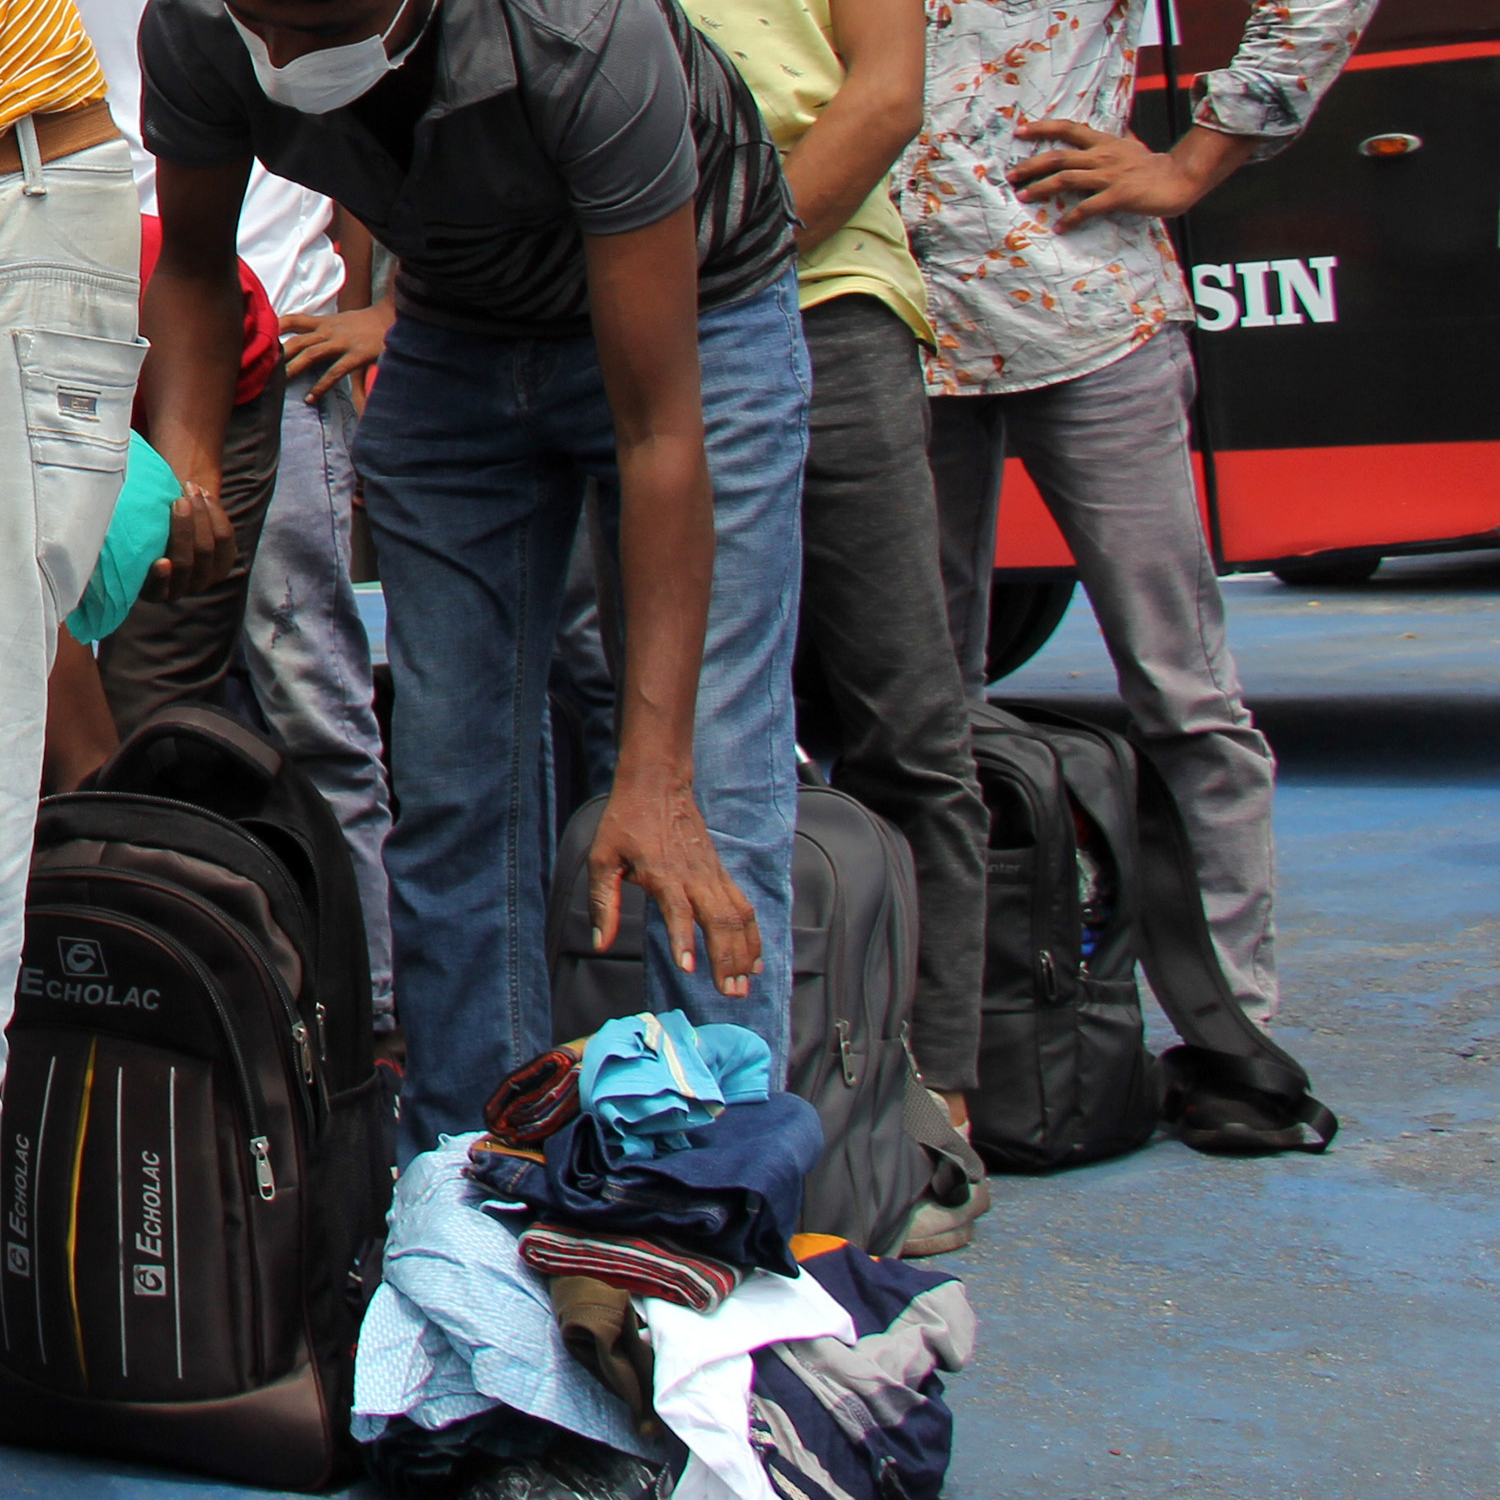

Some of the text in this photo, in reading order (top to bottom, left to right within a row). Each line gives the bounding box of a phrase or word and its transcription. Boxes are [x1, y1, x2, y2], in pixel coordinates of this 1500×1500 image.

[1192, 256, 1339, 332] SIN
[20, 967, 161, 1011] ECHOLAC
[9, 1133, 30, 1239] ECHOLAC
[135, 1150, 163, 1258] ECHOLAC
